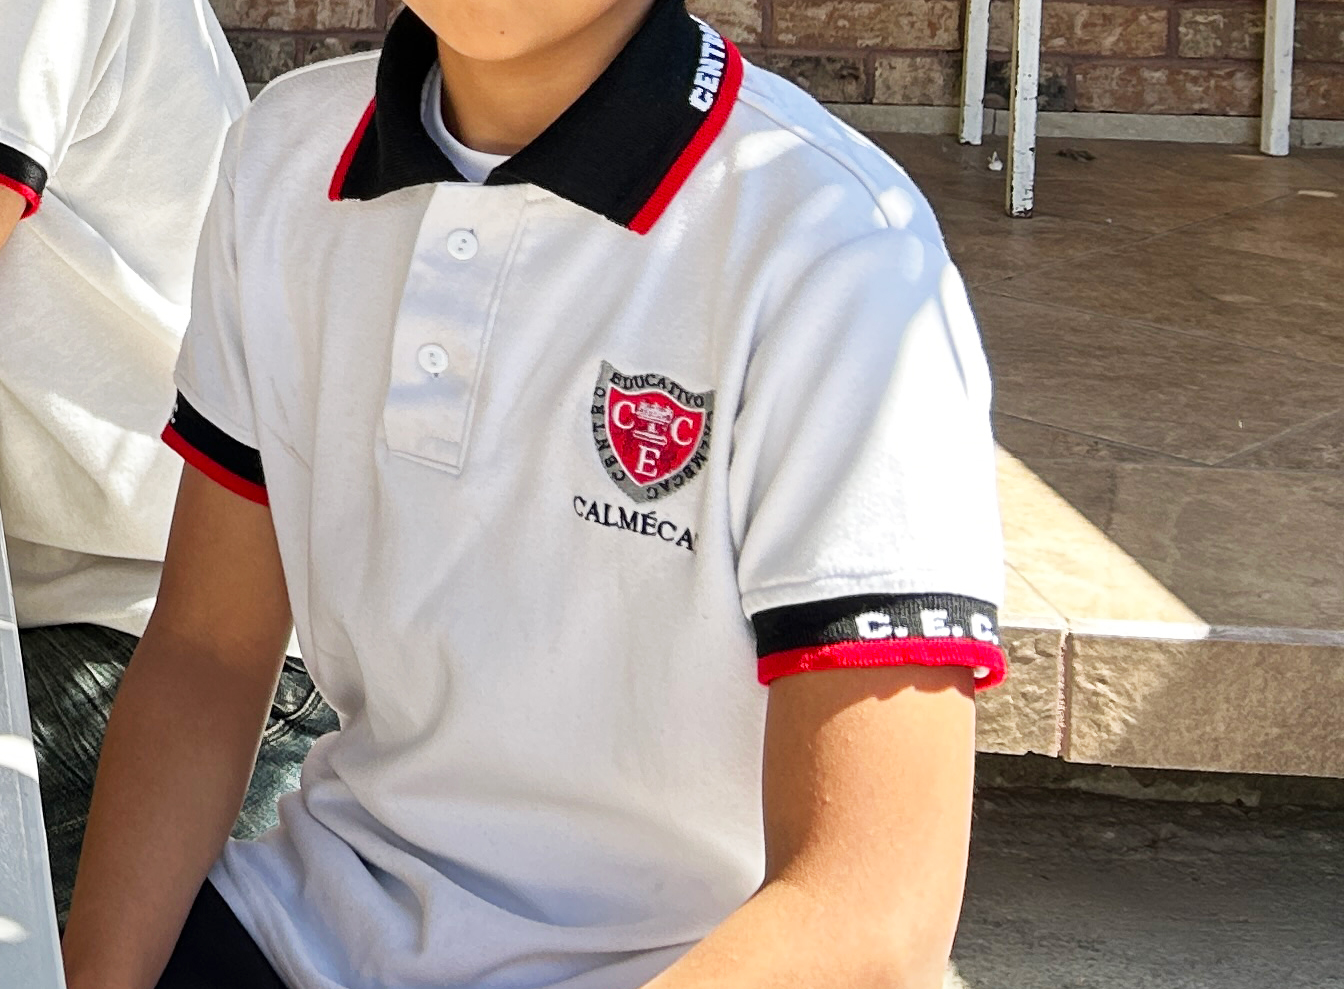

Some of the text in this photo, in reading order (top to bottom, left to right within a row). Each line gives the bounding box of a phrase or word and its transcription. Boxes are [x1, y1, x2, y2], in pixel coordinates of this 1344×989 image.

[609, 371, 705, 408] EDUCATIVO
[635, 444, 661, 478] E
[573, 495, 697, 551] CALMÉCA
